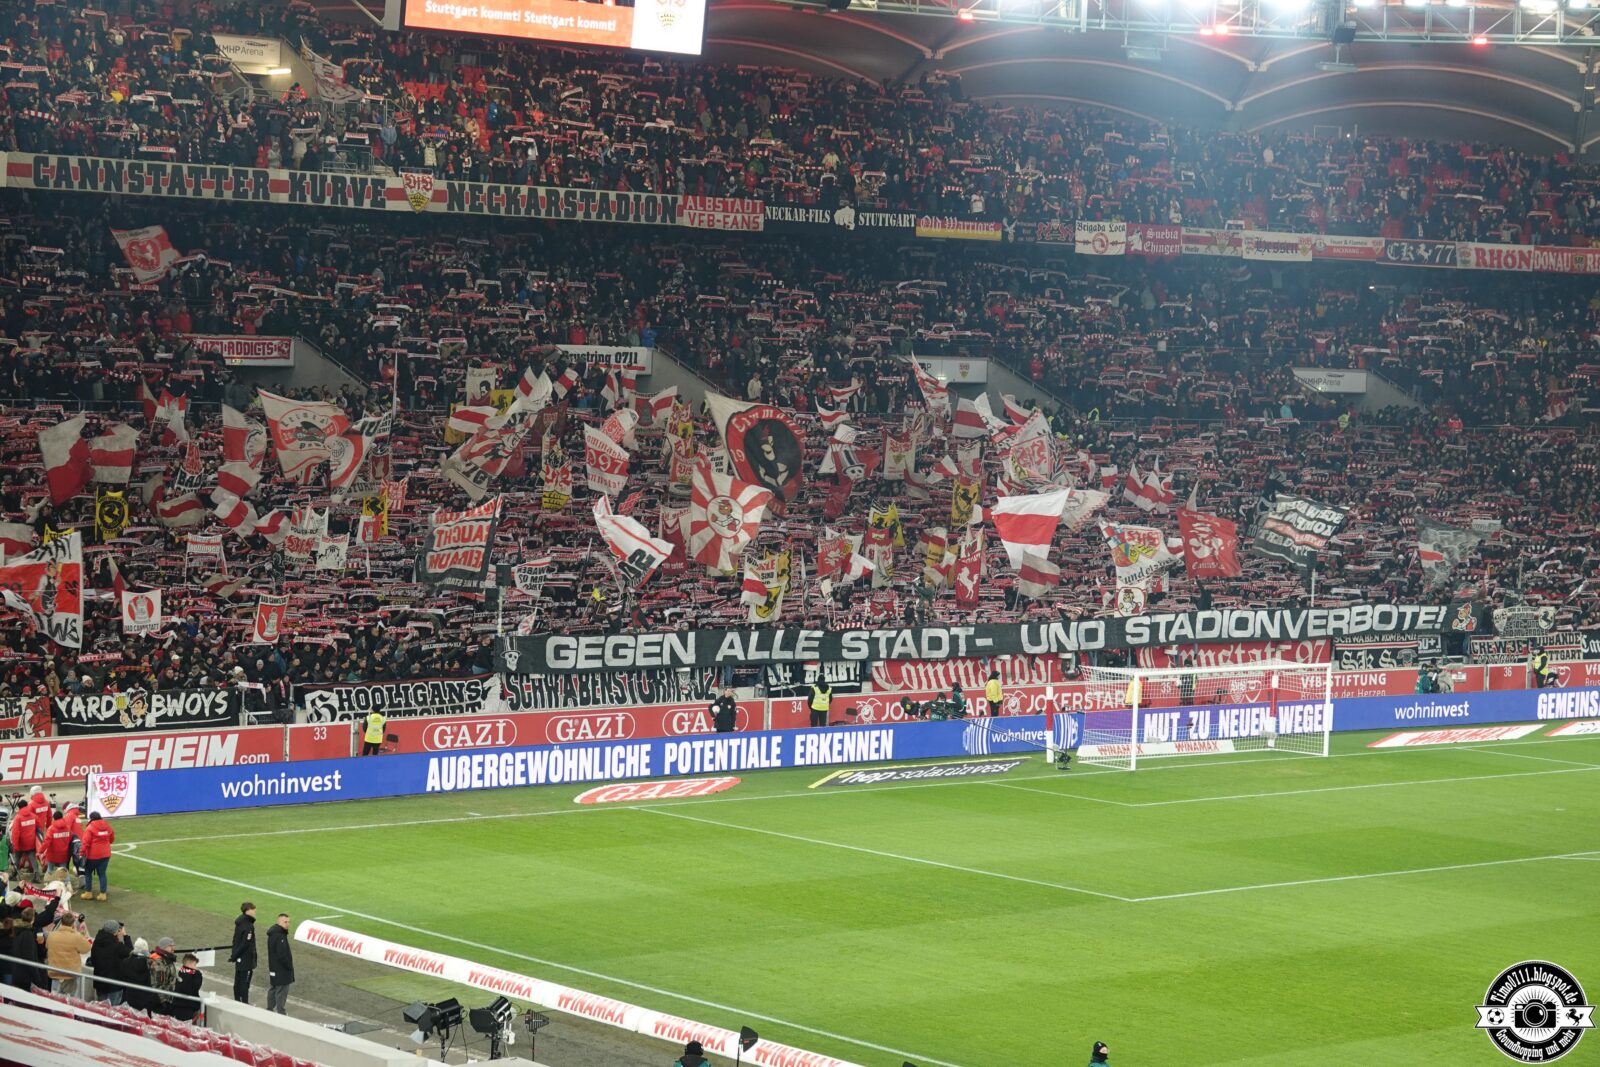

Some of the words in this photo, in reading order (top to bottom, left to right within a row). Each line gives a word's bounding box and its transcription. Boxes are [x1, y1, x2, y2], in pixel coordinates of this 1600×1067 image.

[425, 0, 479, 18] Stuttgart
[480, 5, 521, 22] kommt!
[524, 12, 574, 28] Stuttgart
[577, 17, 616, 32] kommt!
[222, 44, 240, 54] MHP
[241, 46, 264, 56] Arena
[33, 155, 271, 201] CANNSTATTER
[288, 172, 387, 209] KURVE
[446, 182, 679, 225] NECKARSTADION
[685, 199, 764, 214] ALBSTADT
[688, 213, 761, 230] VFB-FANS
[764, 206, 831, 224] NECKAR-FILS
[858, 211, 917, 229] STUTTGART
[919, 215, 942, 232] Old
[943, 216, 995, 235] Warriors
[1434, 244, 1454, 265] 77
[1474, 246, 1533, 270] RHÖN
[1533, 250, 1572, 272] DONAU
[227, 341, 274, 356] ADDICTS
[614, 351, 638, 366] 0711
[545, 631, 697, 670] GEGEN
[715, 630, 824, 662] ALLE
[841, 626, 994, 661] STADT-
[1020, 620, 1106, 654] UND
[1125, 604, 1448, 645] STADIONVERBOTE!
[1471, 640, 1508, 655] CREW
[1508, 640, 1524, 655] 36
[1295, 639, 1327, 664] 97
[1503, 666, 1512, 677] 36
[55, 694, 118, 722] YARD
[151, 690, 229, 719] BWOYS
[333, 679, 482, 712] HOOLIGANS
[791, 700, 802, 714] 34
[1394, 700, 1470, 720] wohninvest
[313, 726, 327, 741] 33
[991, 727, 1048, 744] wohninves
[1143, 711, 1181, 744] MUT
[1188, 710, 1212, 741] ZU
[663, 735, 784, 776] POTENTIALE
[793, 728, 895, 767] ERKENNEN
[891, 760, 1022, 782] solarinvest
[98, 774, 129, 792] VfB
[221, 770, 342, 799] wohninvest
